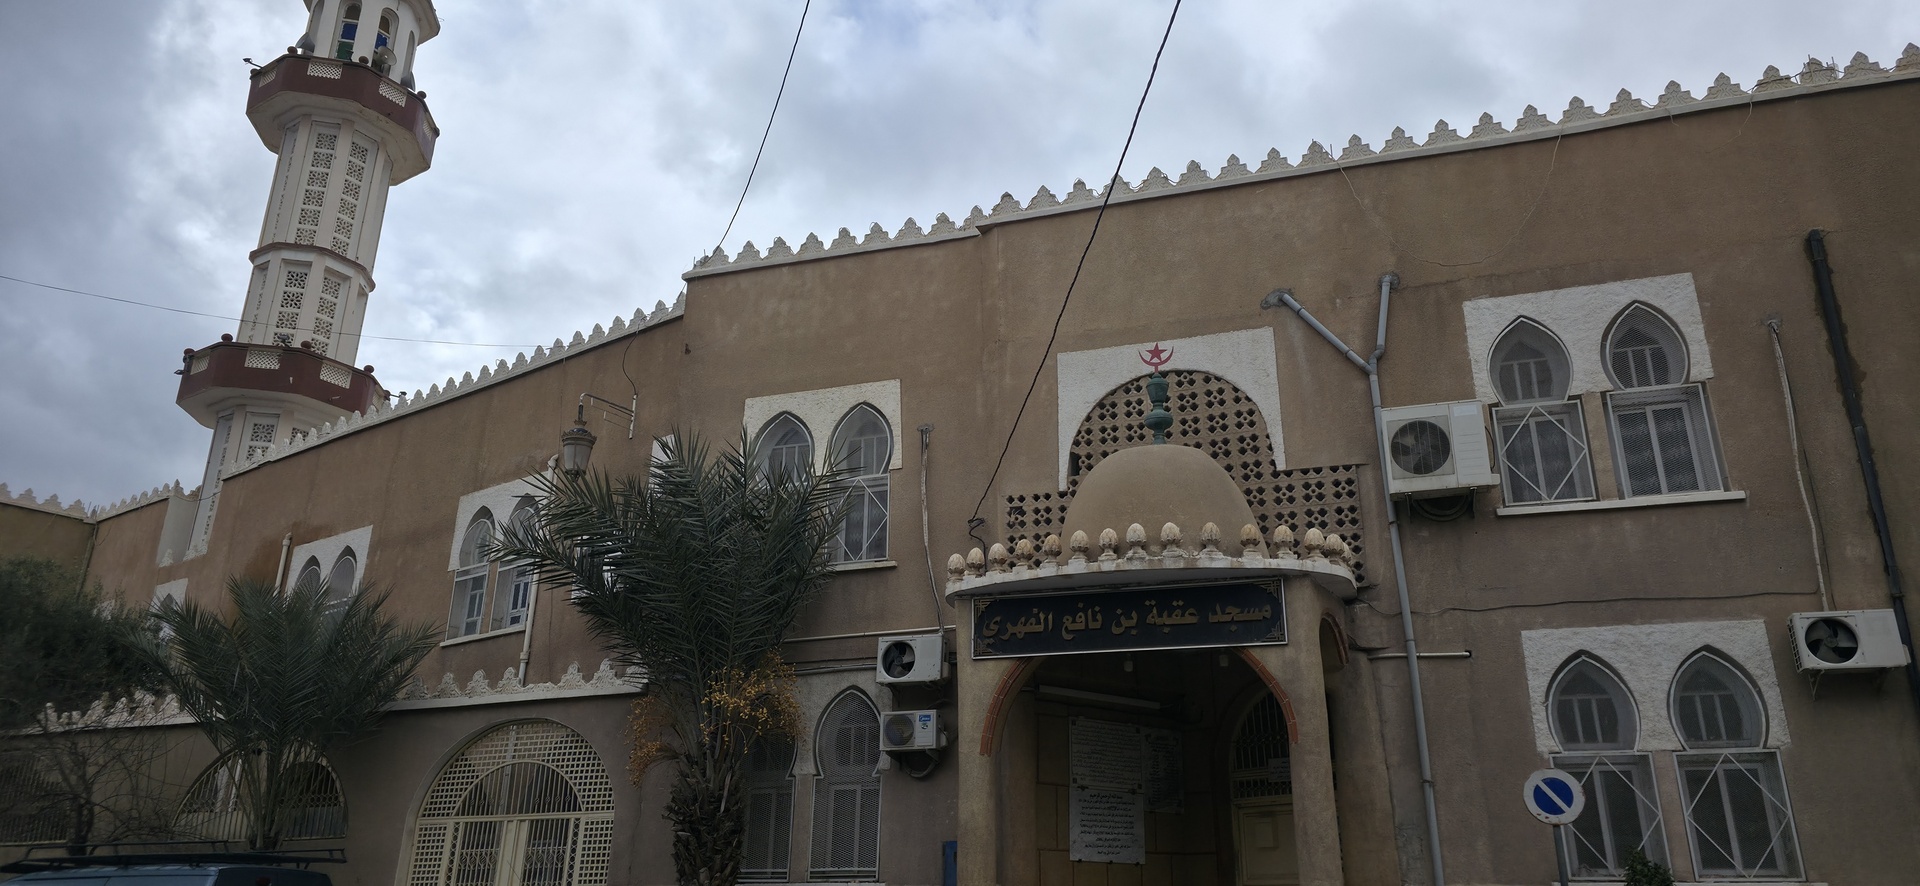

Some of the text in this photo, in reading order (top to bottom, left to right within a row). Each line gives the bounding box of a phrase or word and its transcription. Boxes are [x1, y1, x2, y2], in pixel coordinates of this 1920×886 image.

[982, 598, 1272, 645] مسجد عقبة بن نافع الفهري
